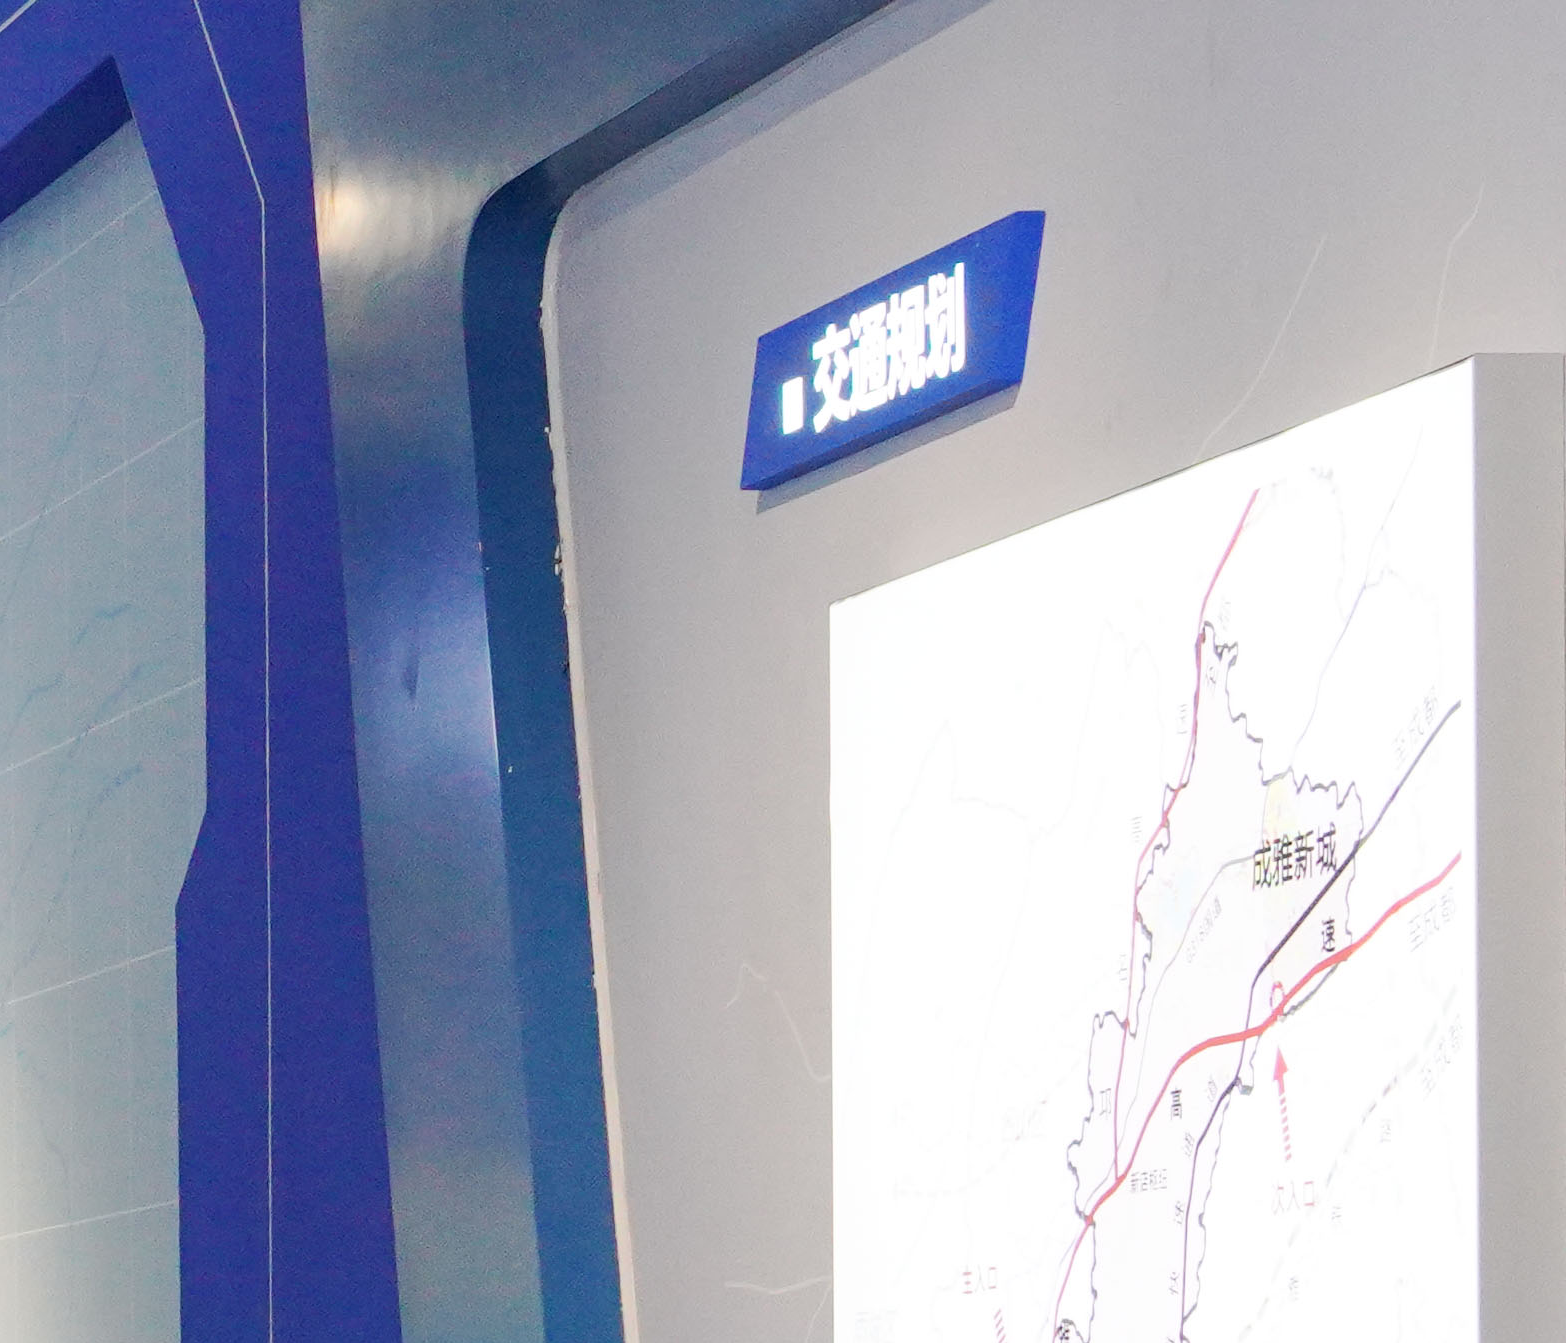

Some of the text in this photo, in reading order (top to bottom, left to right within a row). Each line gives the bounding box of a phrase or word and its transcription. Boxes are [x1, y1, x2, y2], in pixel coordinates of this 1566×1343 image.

[812, 262, 965, 433] 交通规划
[1252, 822, 1339, 890] 成雅新城
